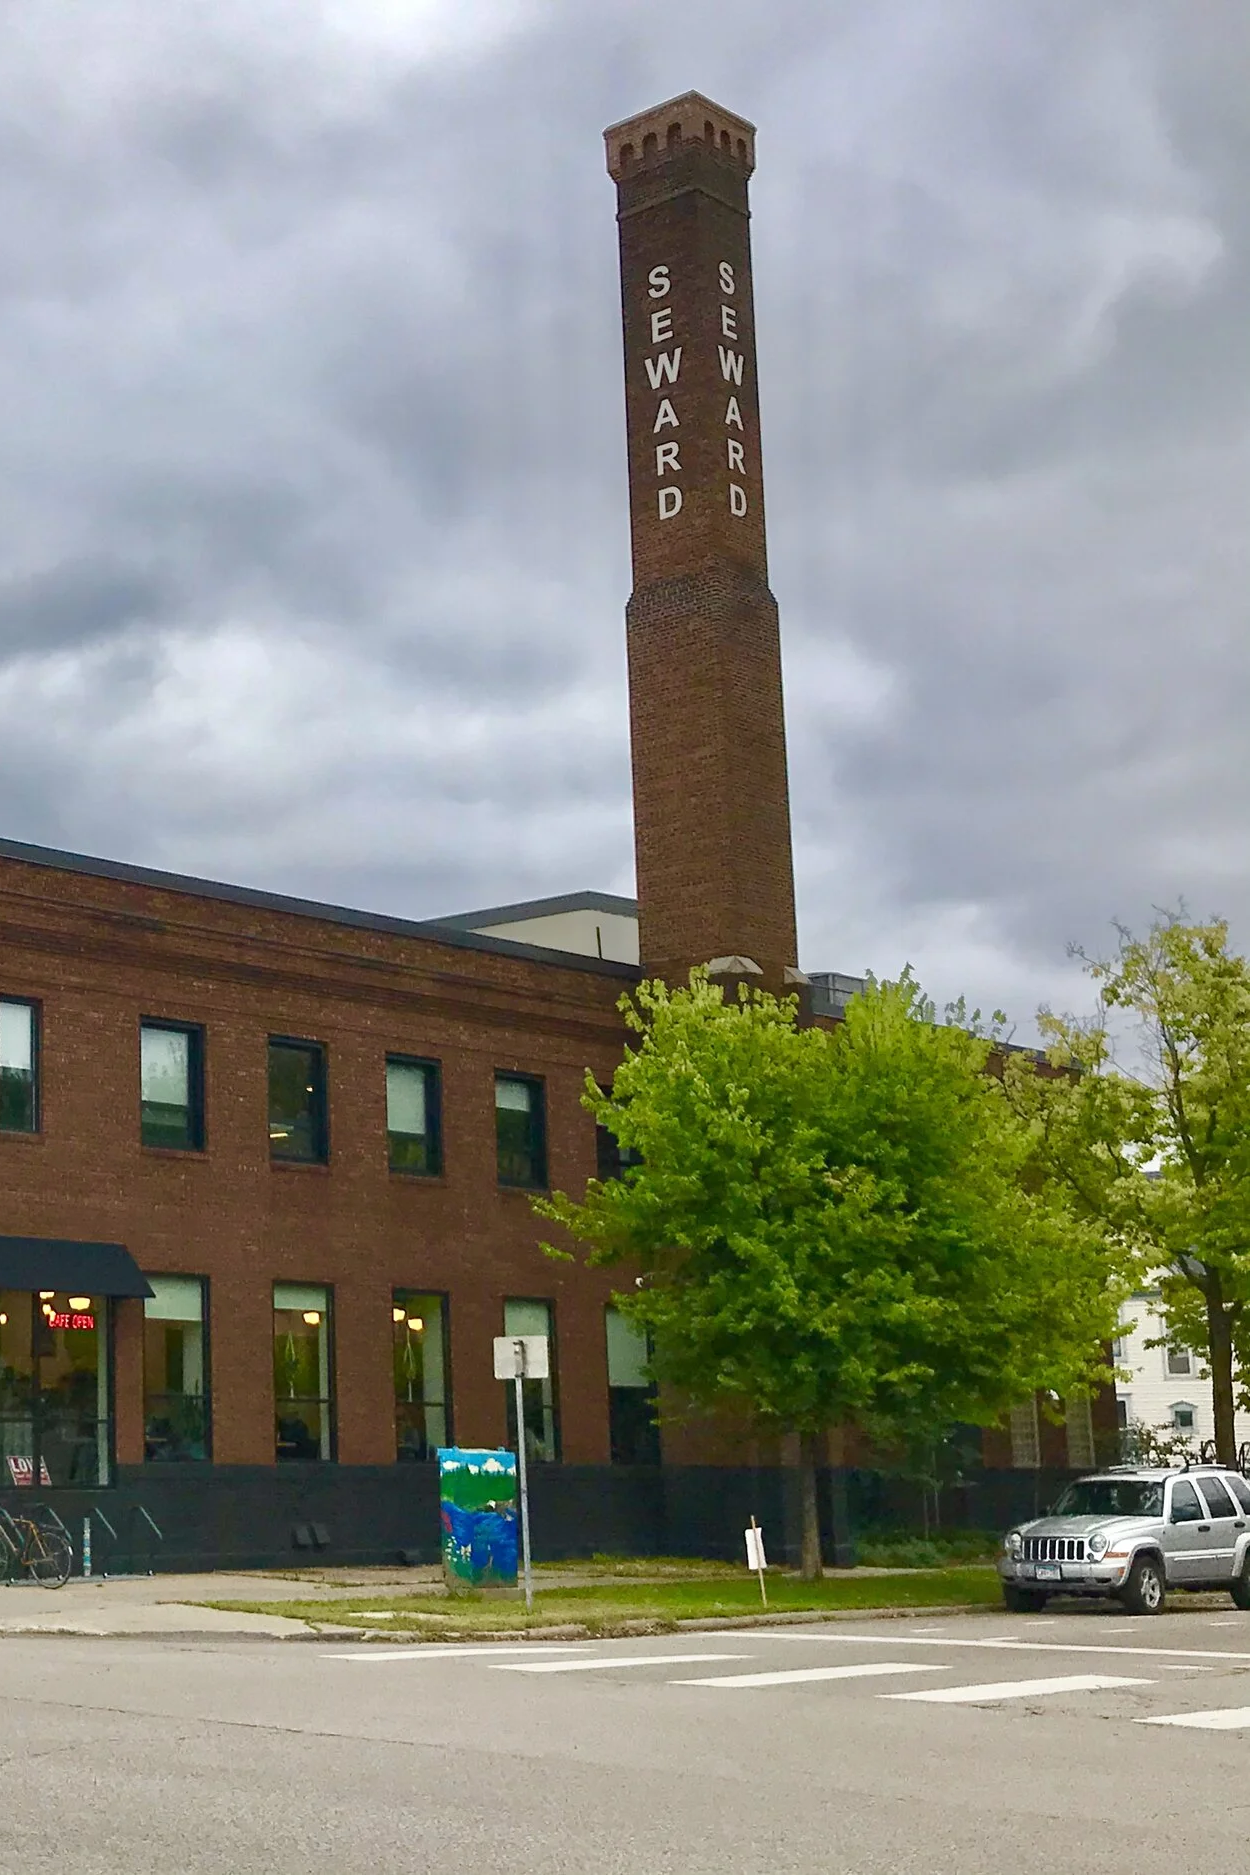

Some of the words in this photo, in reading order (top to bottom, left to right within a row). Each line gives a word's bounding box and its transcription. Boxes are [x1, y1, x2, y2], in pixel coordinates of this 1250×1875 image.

[644, 264, 683, 521] SEWARD
[717, 260, 748, 519] SEWARD
[72, 1314, 94, 1329] OPEN
